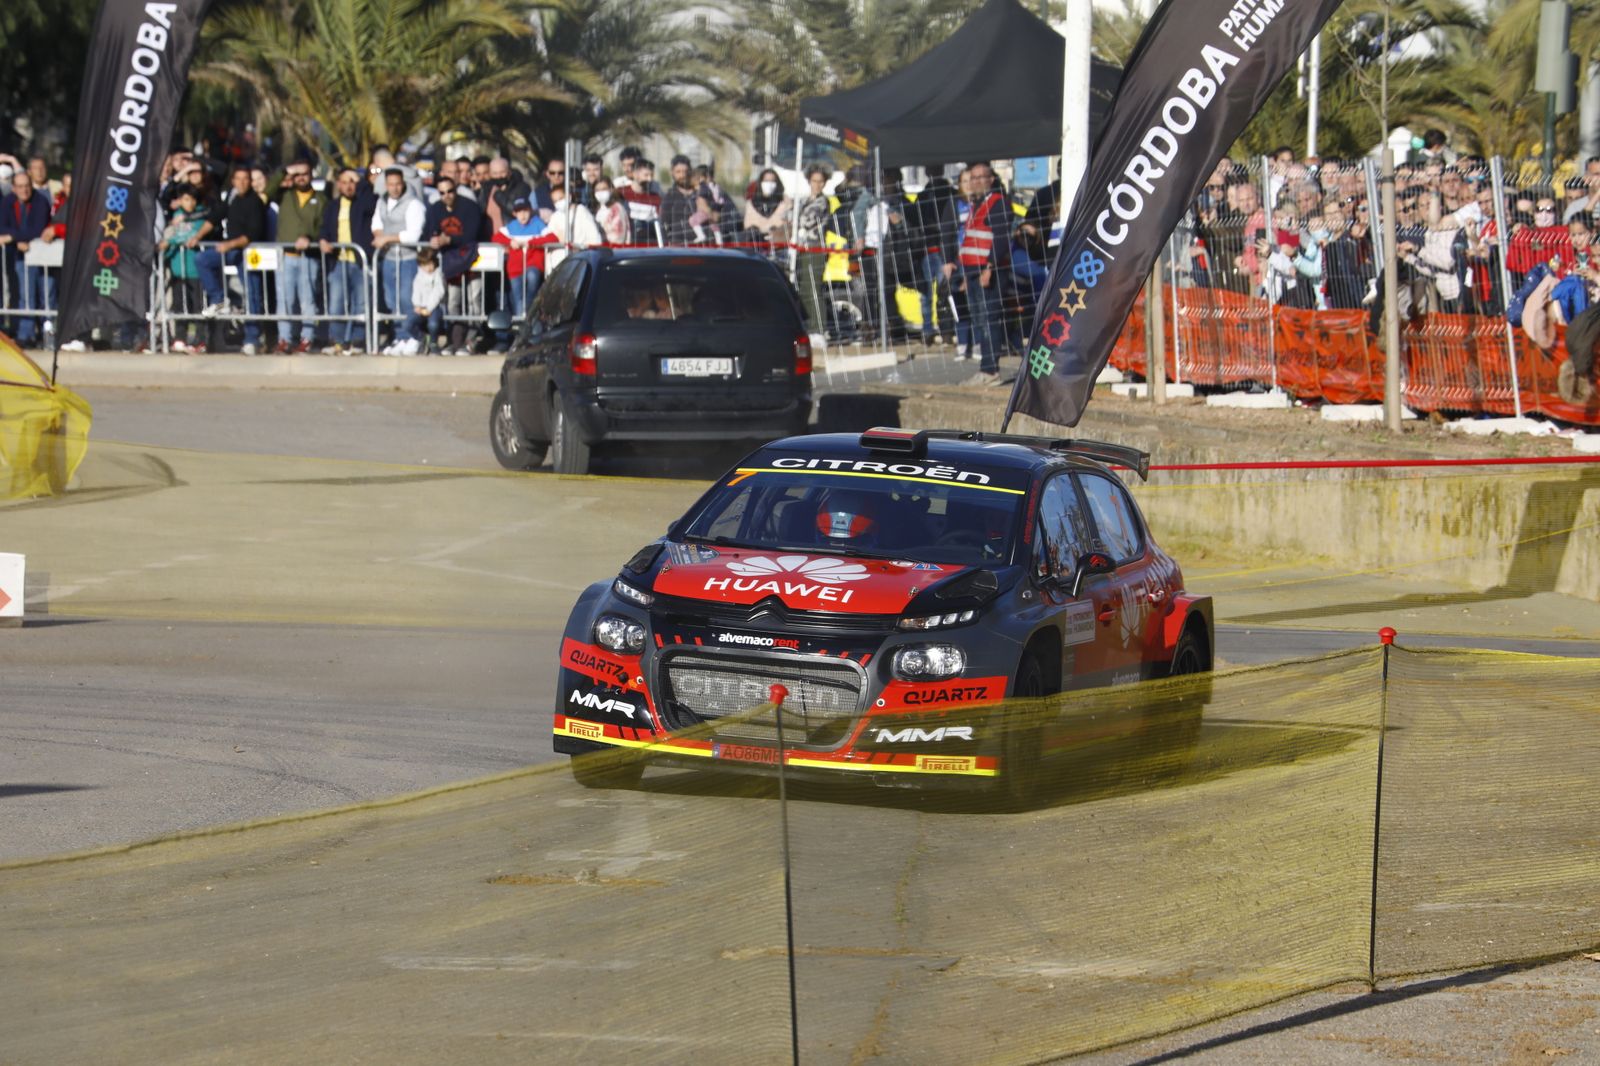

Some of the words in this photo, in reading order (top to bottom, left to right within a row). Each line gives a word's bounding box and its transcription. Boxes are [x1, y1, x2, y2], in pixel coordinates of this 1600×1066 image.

[109, 2, 177, 175] CÓRDOBA
[1095, 43, 1241, 246] CÓRDOBA
[670, 360, 702, 372] 4654
[705, 360, 730, 372] FJJ
[727, 471, 759, 487] 7
[771, 458, 990, 484] CITROËN
[703, 577, 854, 603] HUAWEI
[719, 632, 800, 649] alvemacorent
[570, 650, 624, 679] QUARTZ
[570, 690, 636, 719] MMR
[903, 686, 988, 705] QUARTZ
[568, 722, 601, 738] PIRELLI
[876, 727, 975, 743] MMR
[921, 757, 970, 771] PIRELLI
